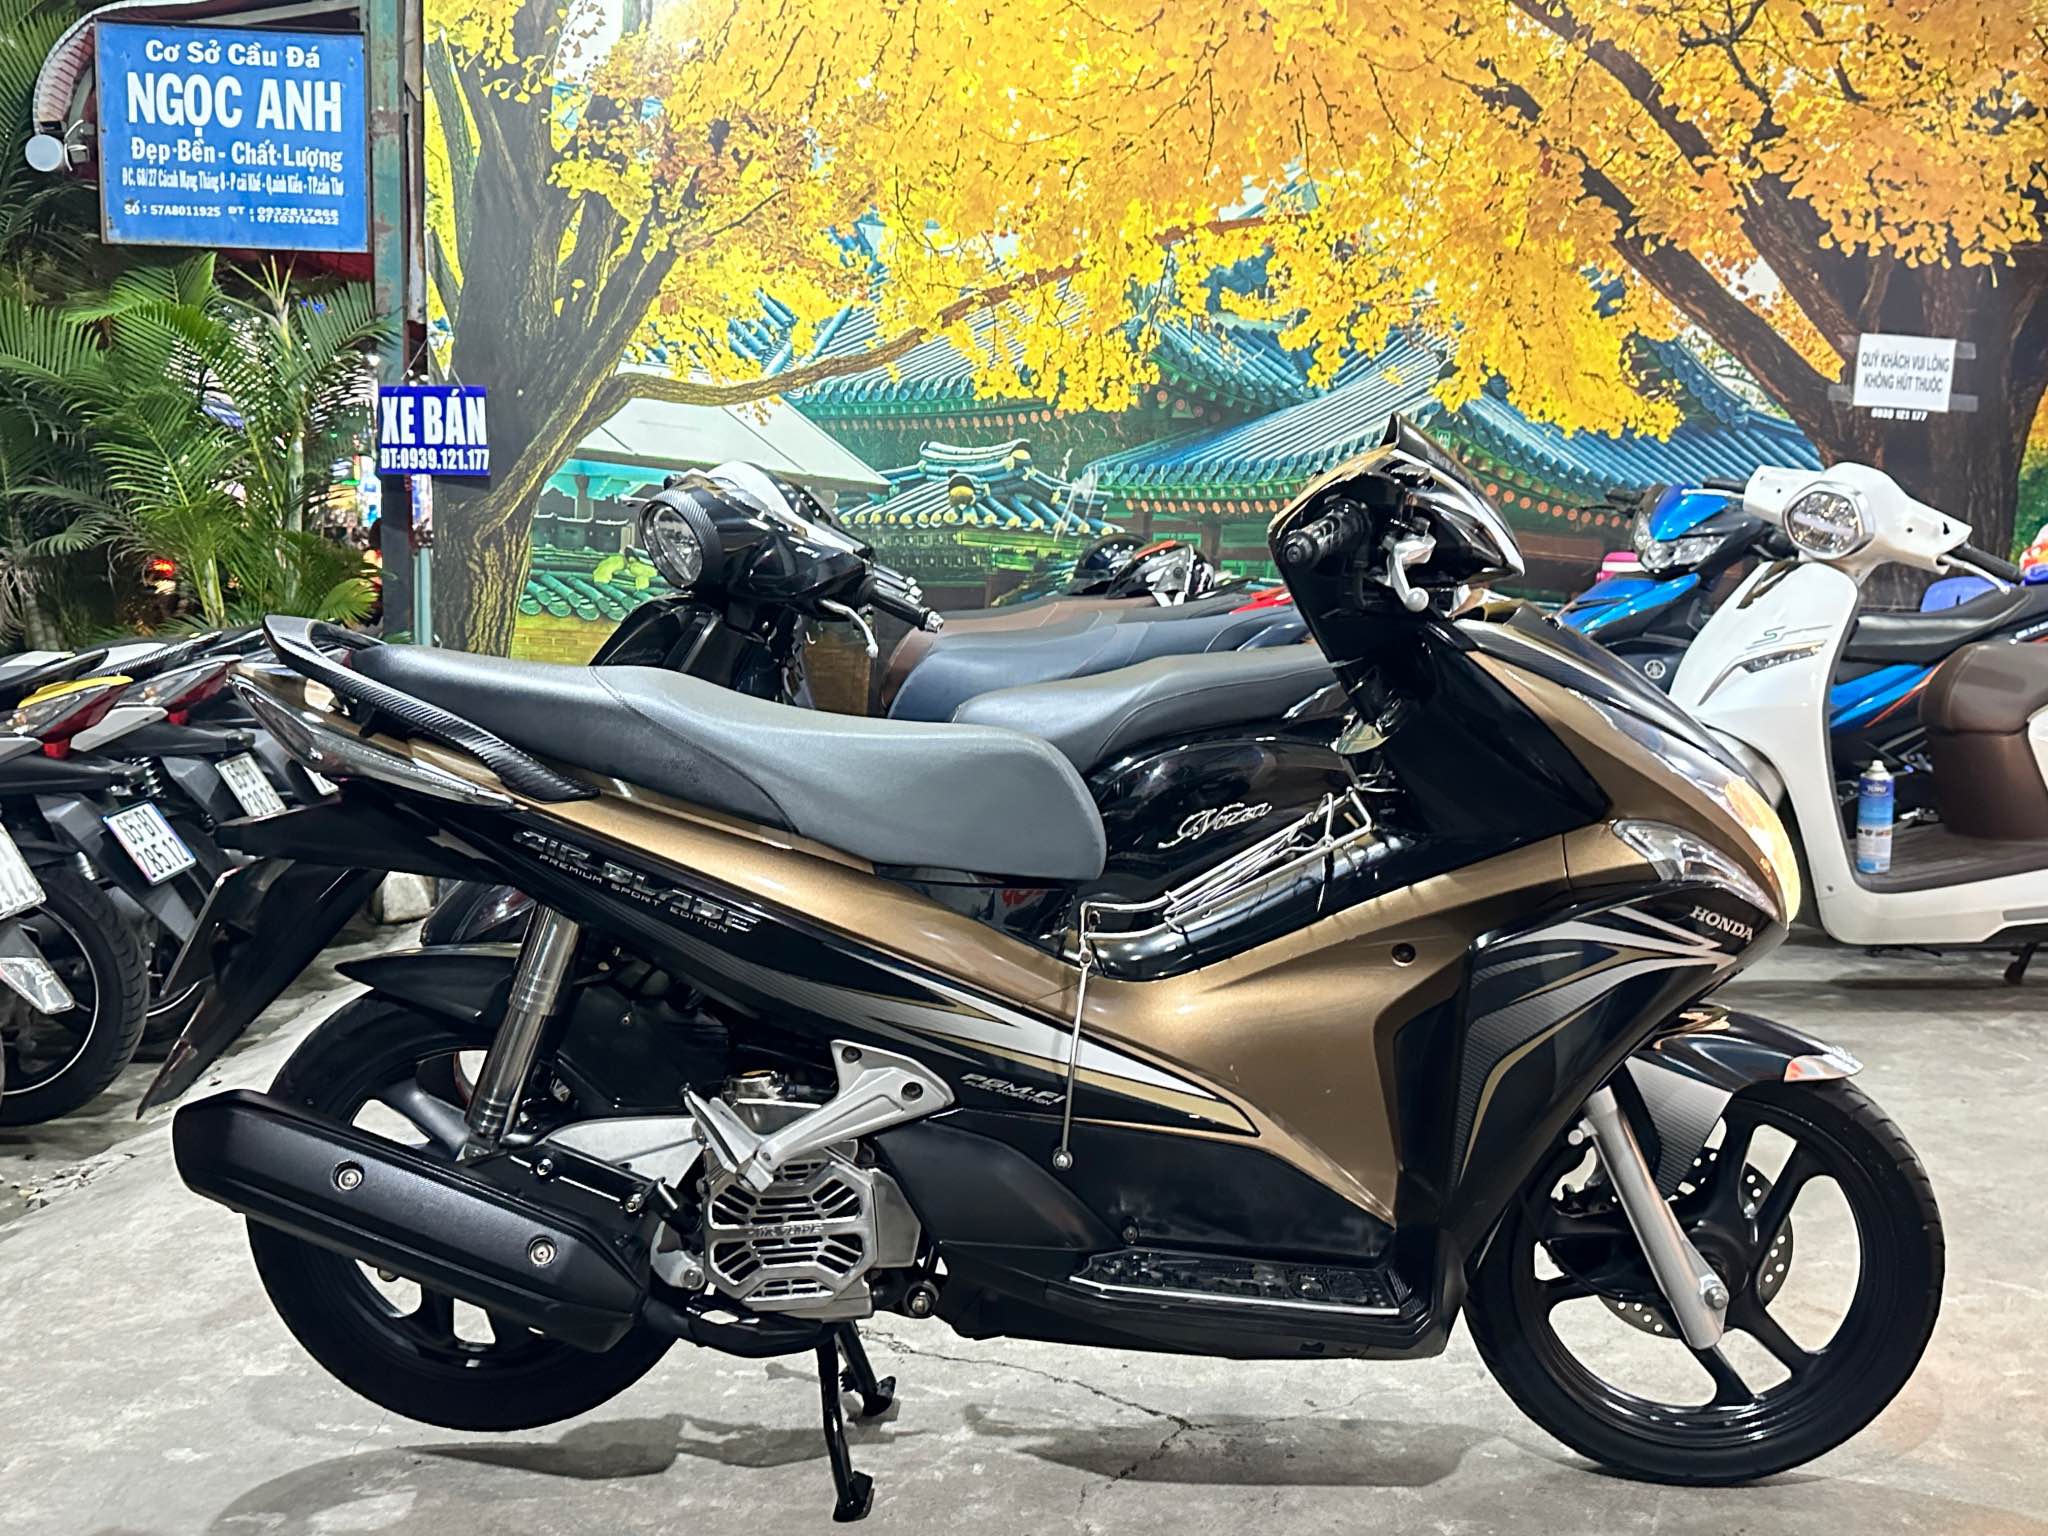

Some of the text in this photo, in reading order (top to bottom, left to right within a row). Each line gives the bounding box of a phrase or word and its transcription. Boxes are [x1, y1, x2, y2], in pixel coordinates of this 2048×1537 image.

[145, 38, 321, 69] Cơ Sở Cầu Đá
[126, 71, 343, 137] NGỌC ANH
[381, 388, 488, 445] XE BÁN
[136, 836, 190, 878] 285.12
[513, 830, 762, 932] AIR BLADE
[538, 853, 729, 934] PREMIUM SPORT EDITION
[1689, 905, 1754, 943] HONDA
